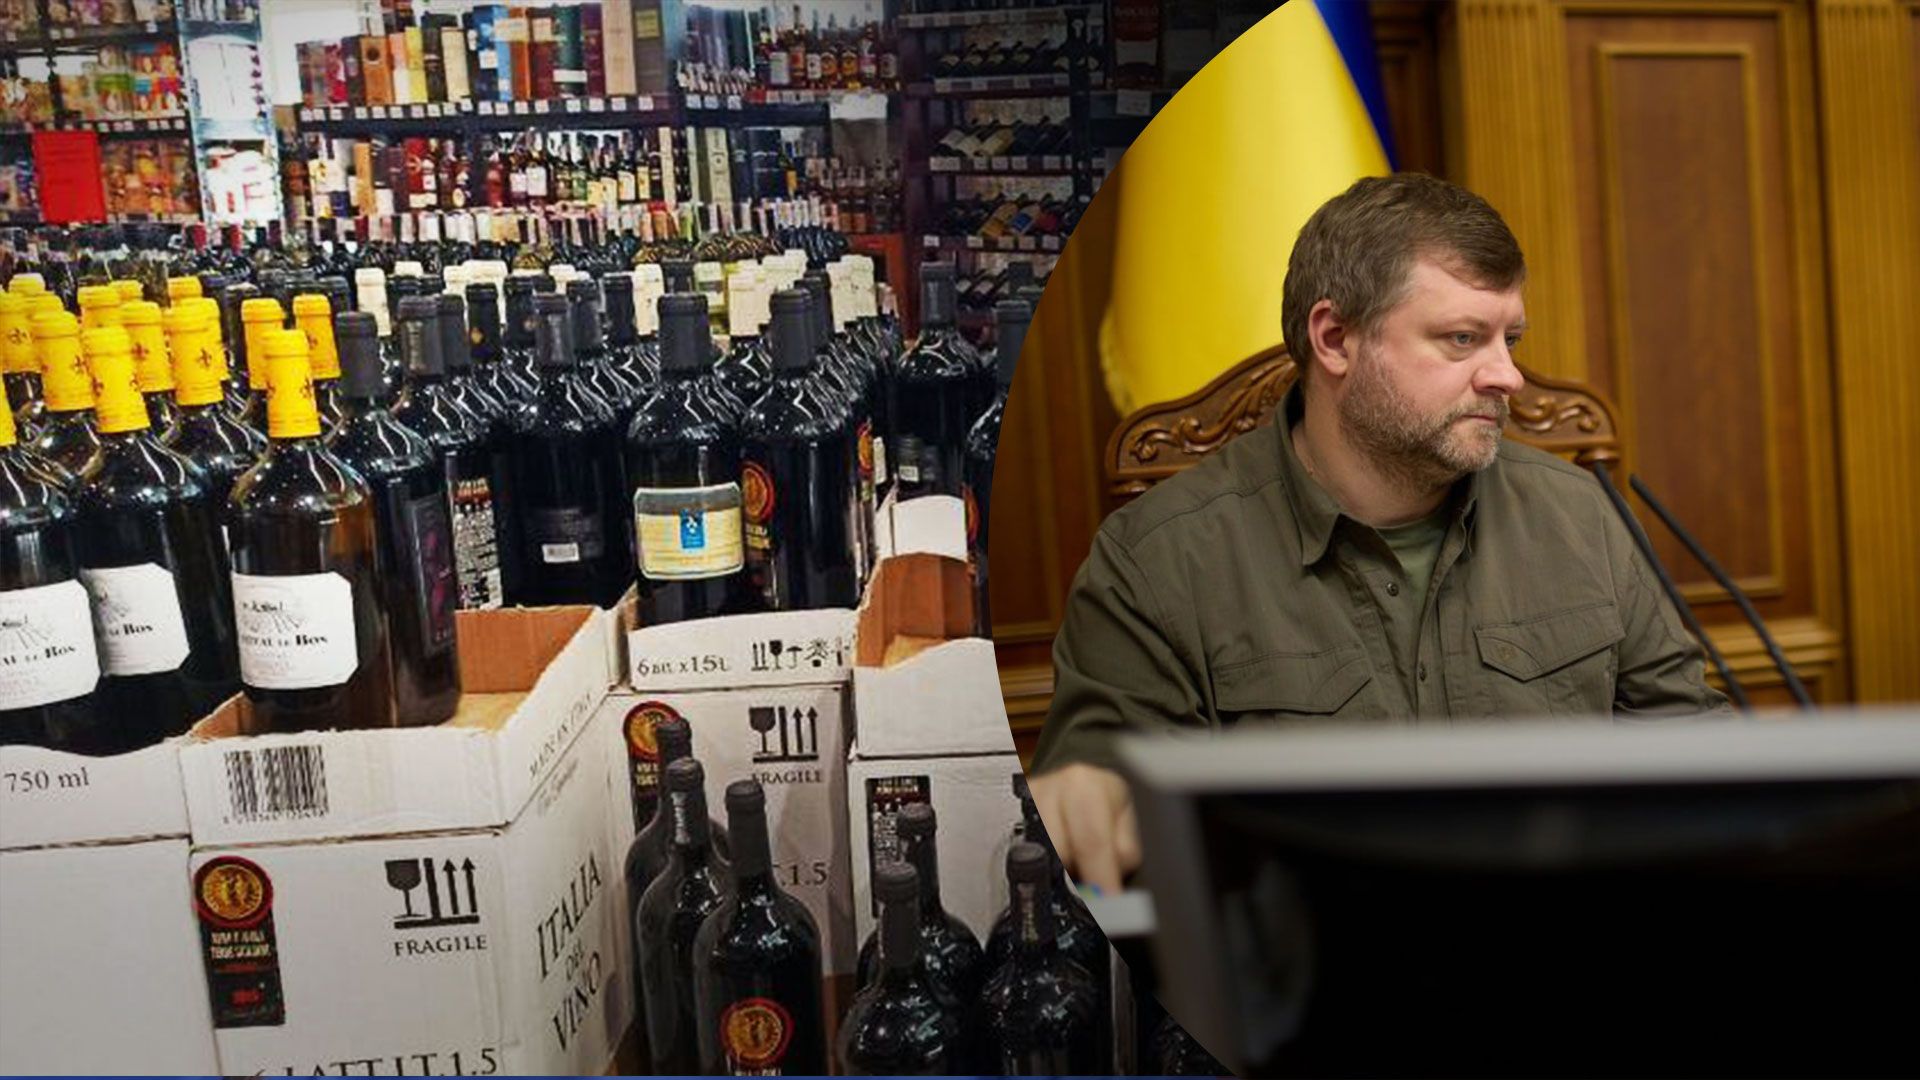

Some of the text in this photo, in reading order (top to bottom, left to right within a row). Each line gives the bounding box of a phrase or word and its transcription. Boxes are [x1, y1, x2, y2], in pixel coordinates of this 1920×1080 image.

[637, 659, 650, 677] 6
[3, 765, 90, 792] 750 ml
[536, 852, 602, 978] ITALIA
[393, 933, 488, 957] FRAGILE
[552, 950, 602, 1052] VINO
